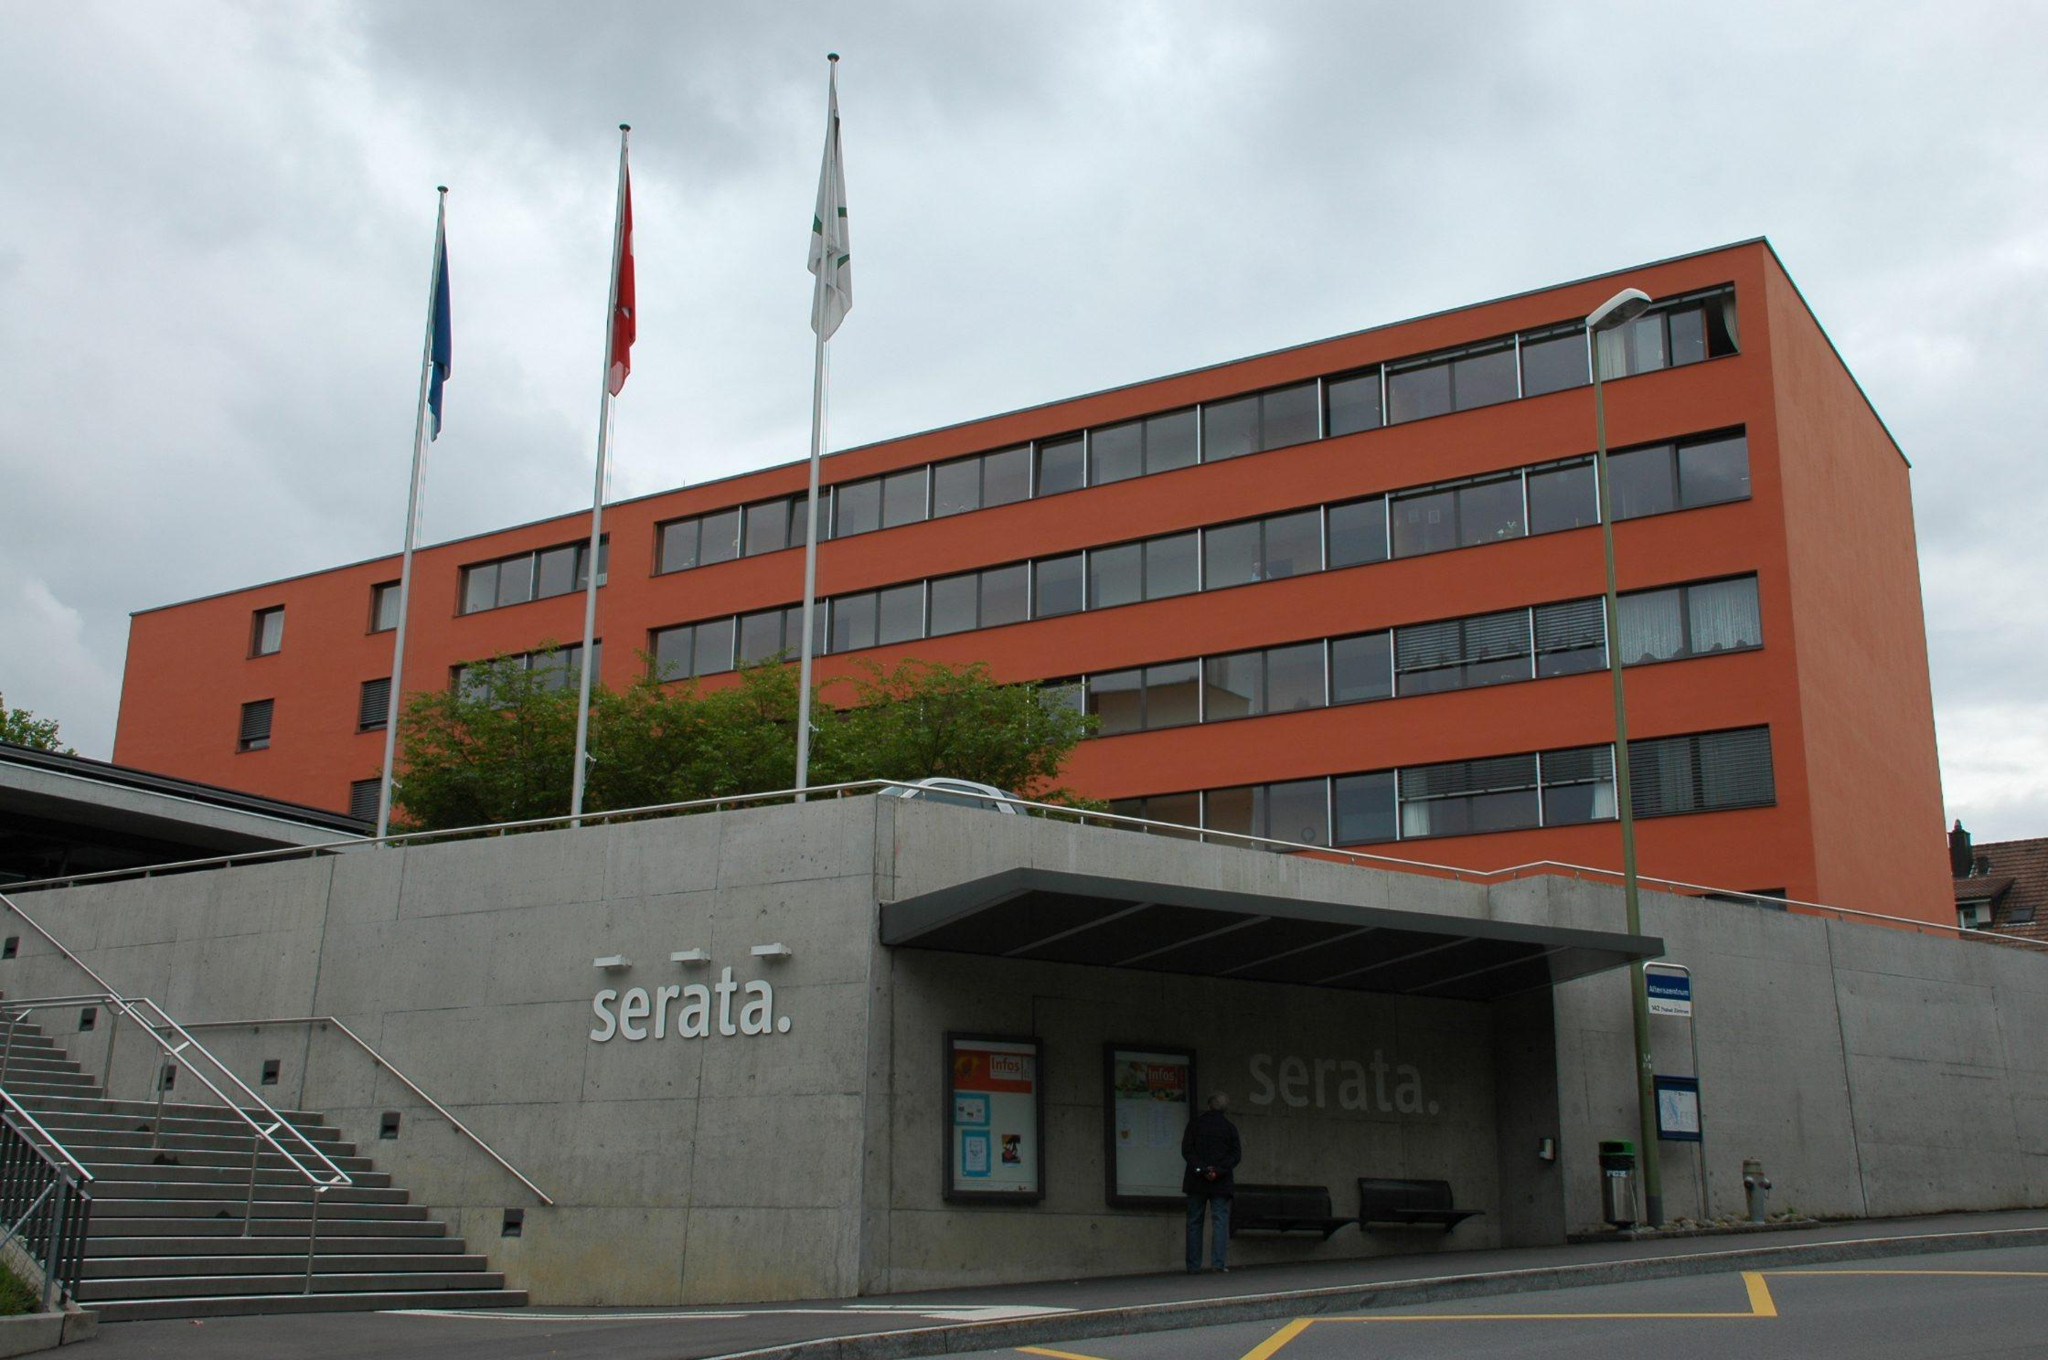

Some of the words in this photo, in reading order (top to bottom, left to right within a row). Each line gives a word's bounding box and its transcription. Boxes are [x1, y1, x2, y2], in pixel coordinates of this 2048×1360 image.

[1649, 985, 1689, 996] Alterszentrum
[590, 966, 791, 1042] serata.
[991, 1056, 1020, 1072] Infos
[1148, 1067, 1175, 1081] Infos
[1249, 1050, 1439, 1114] serata.
